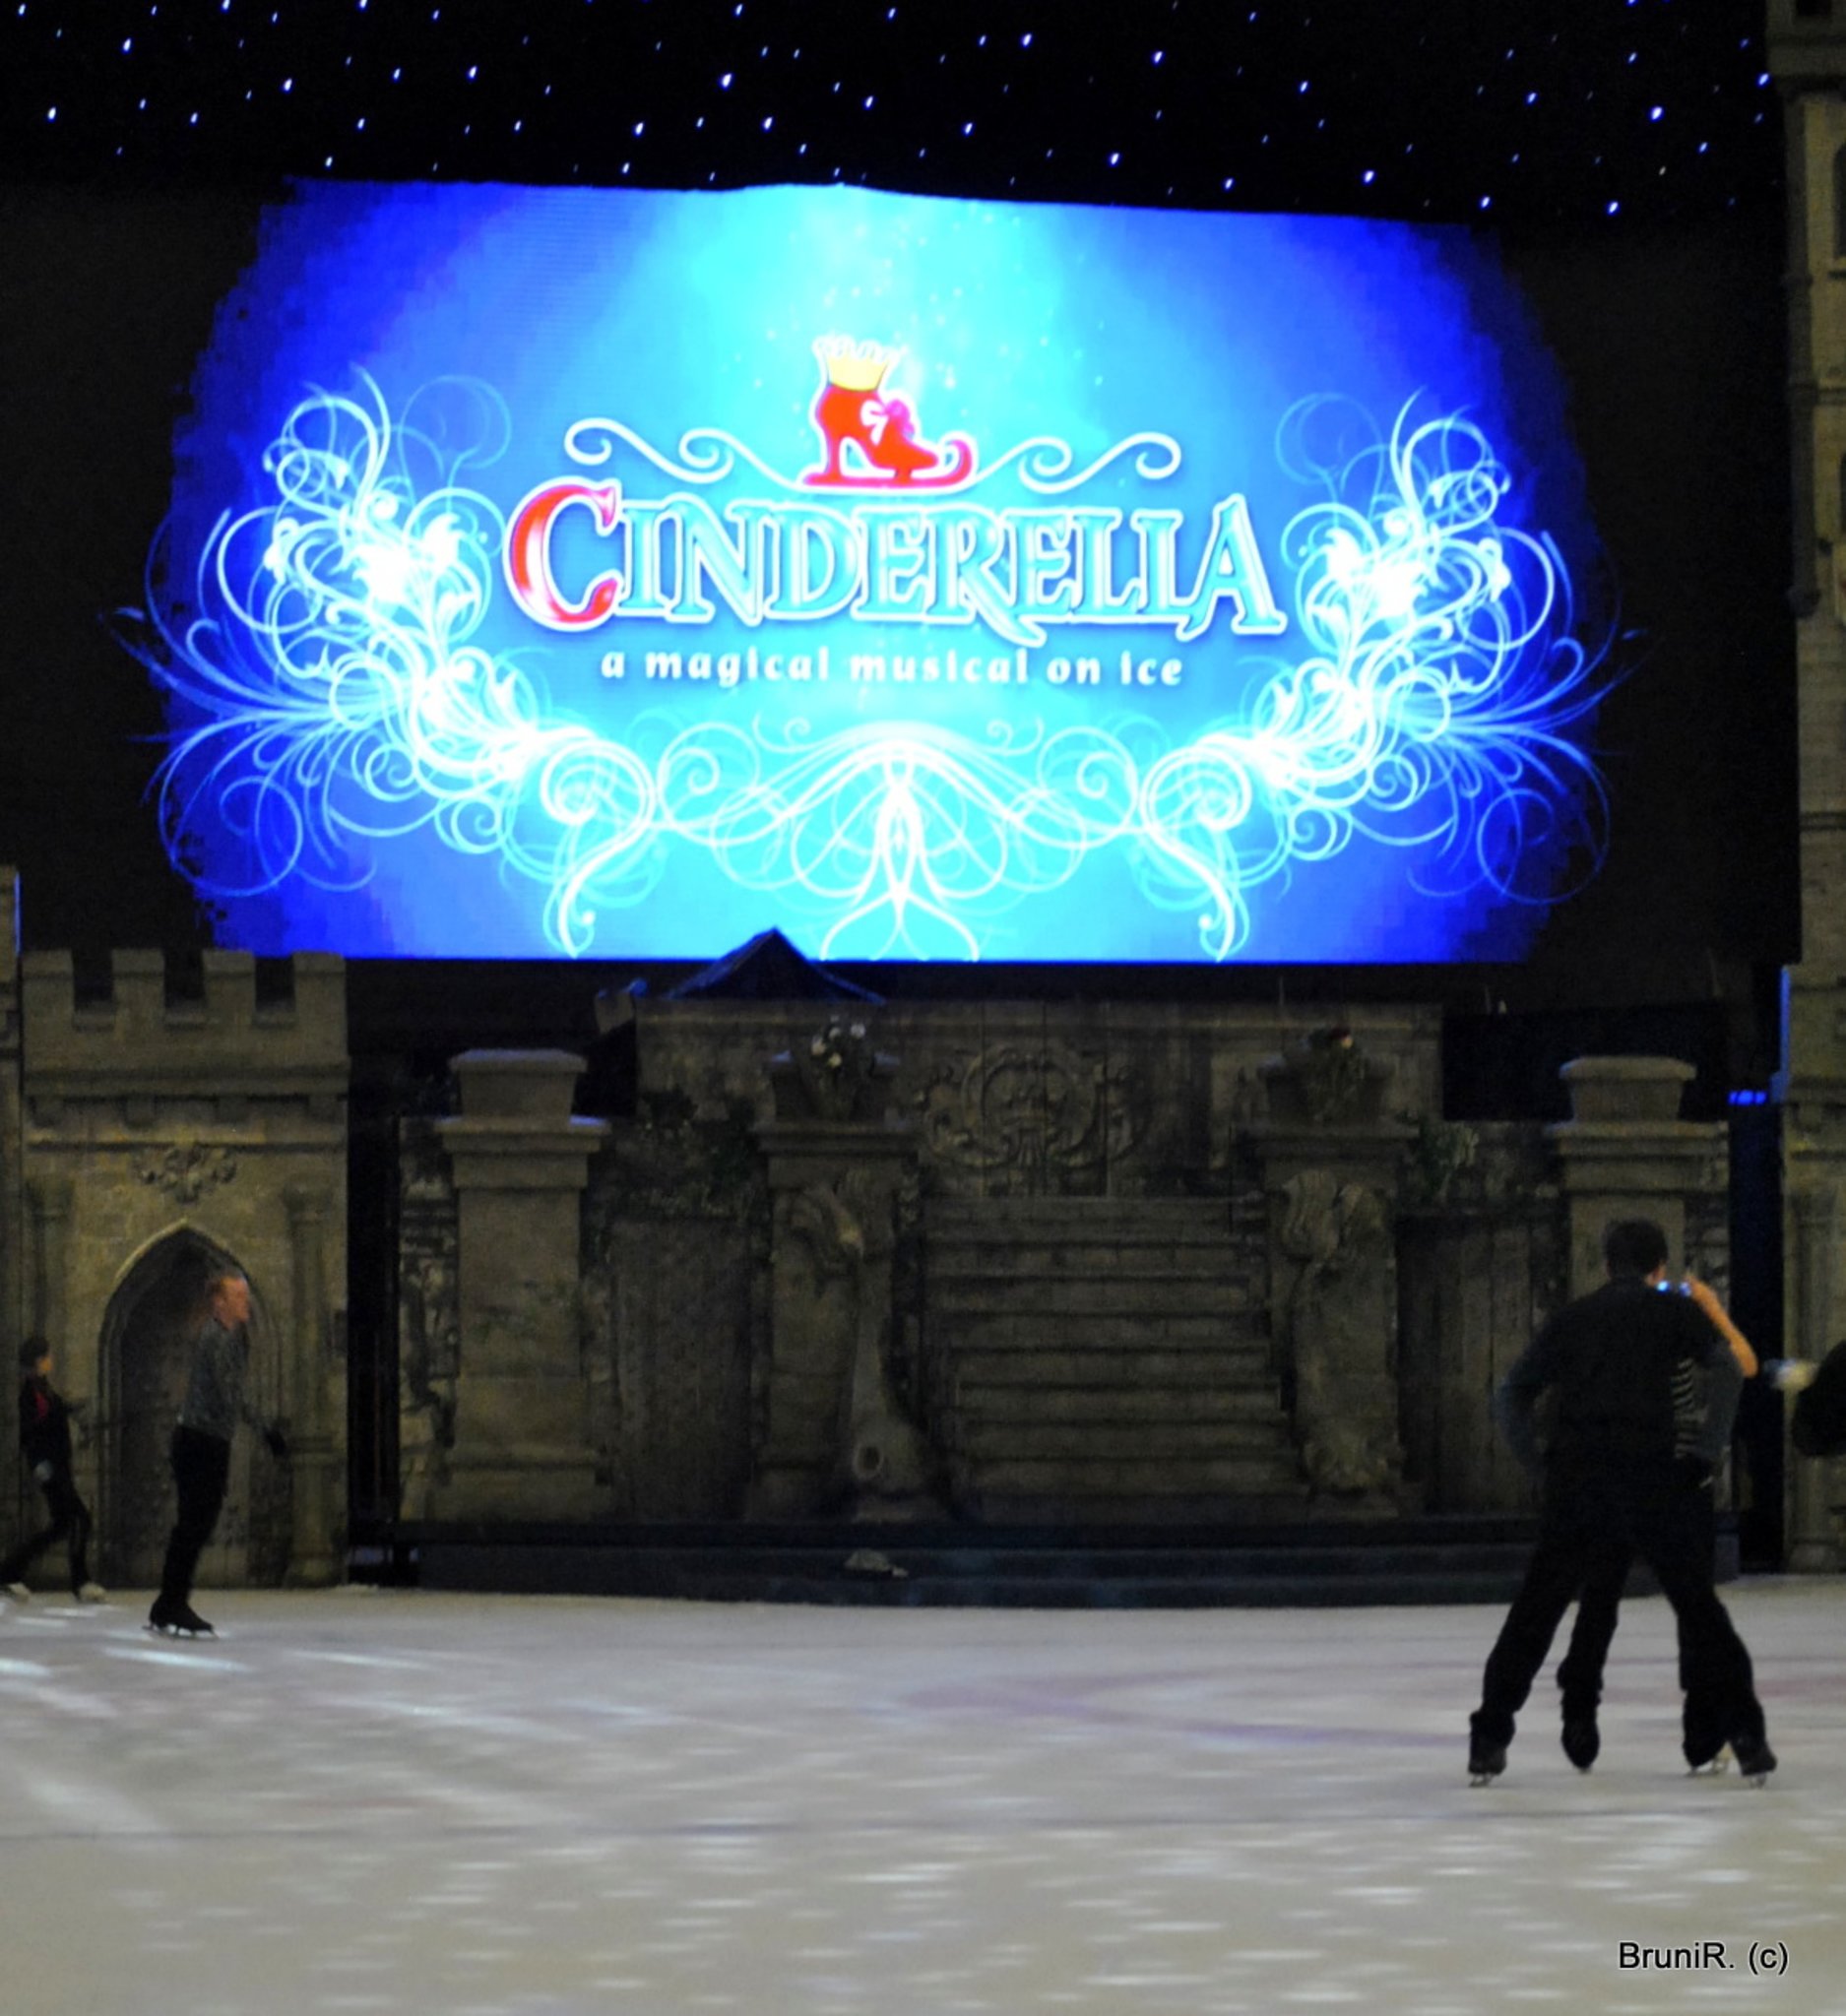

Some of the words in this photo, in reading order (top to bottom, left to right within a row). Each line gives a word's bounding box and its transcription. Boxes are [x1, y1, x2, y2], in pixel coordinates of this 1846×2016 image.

[504, 477, 1287, 648] CINDERELLA
[601, 654, 626, 680] a
[645, 647, 830, 688] magical
[850, 648, 1028, 686] musical
[1048, 658, 1101, 685] on
[1120, 651, 1182, 686] ice
